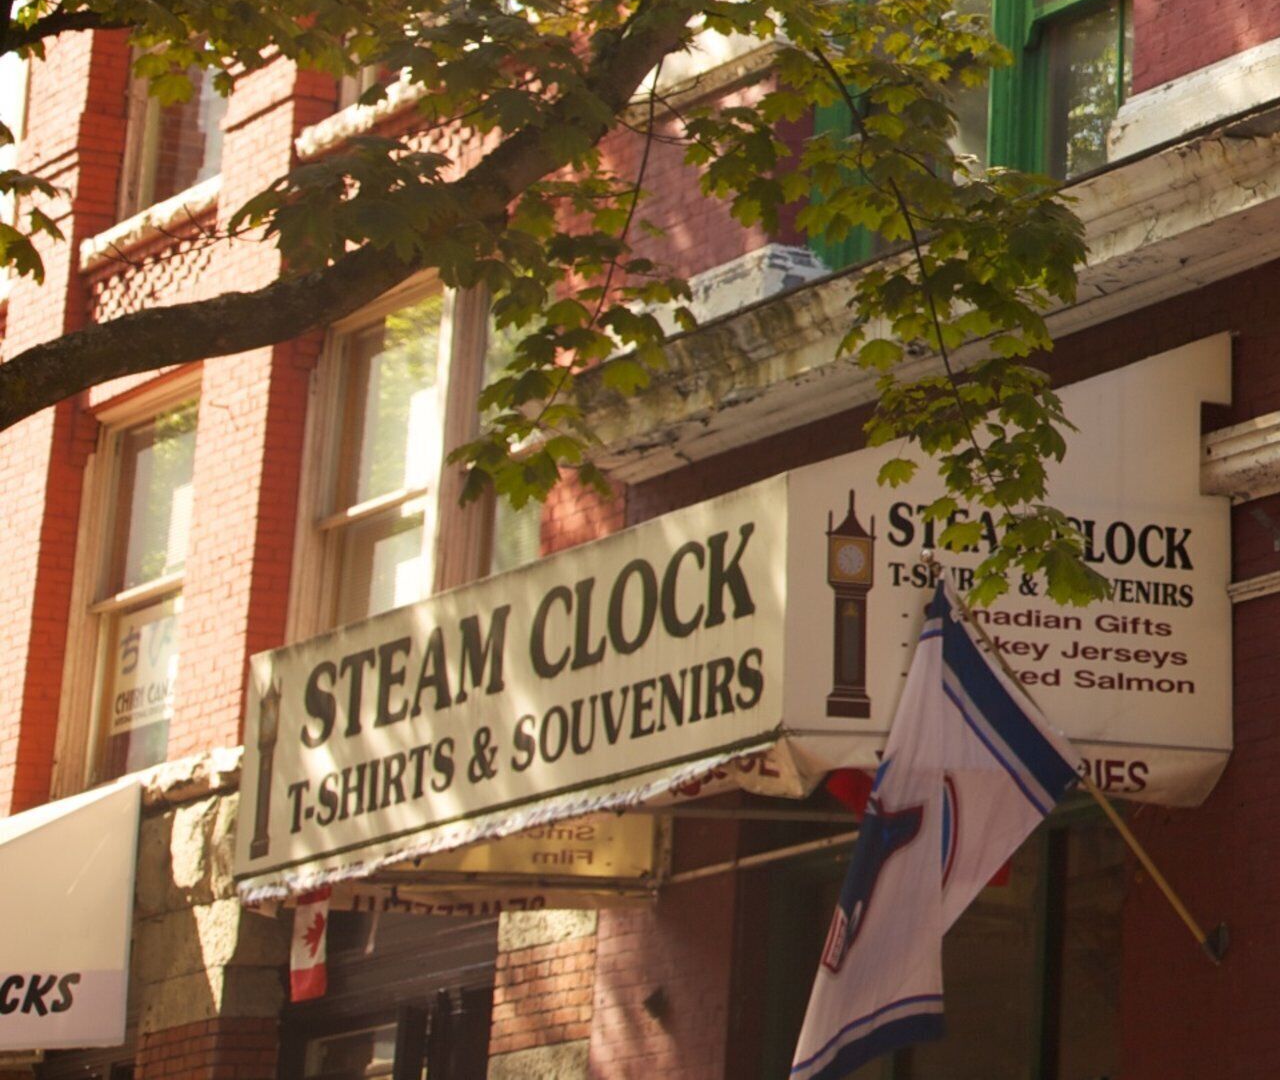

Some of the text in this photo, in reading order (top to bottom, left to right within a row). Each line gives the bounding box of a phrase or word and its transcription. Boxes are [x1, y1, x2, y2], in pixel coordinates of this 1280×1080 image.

[1056, 516, 1194, 571] LOCK
[1018, 573, 1039, 597] &
[301, 521, 756, 749] STEAM CLOCK
[1094, 614, 1174, 637] Gifts
[1060, 641, 1189, 669] Jerseys
[1074, 669, 1196, 695] Salmon
[288, 645, 764, 834] T-SHIRTS & SOUVENIRS
